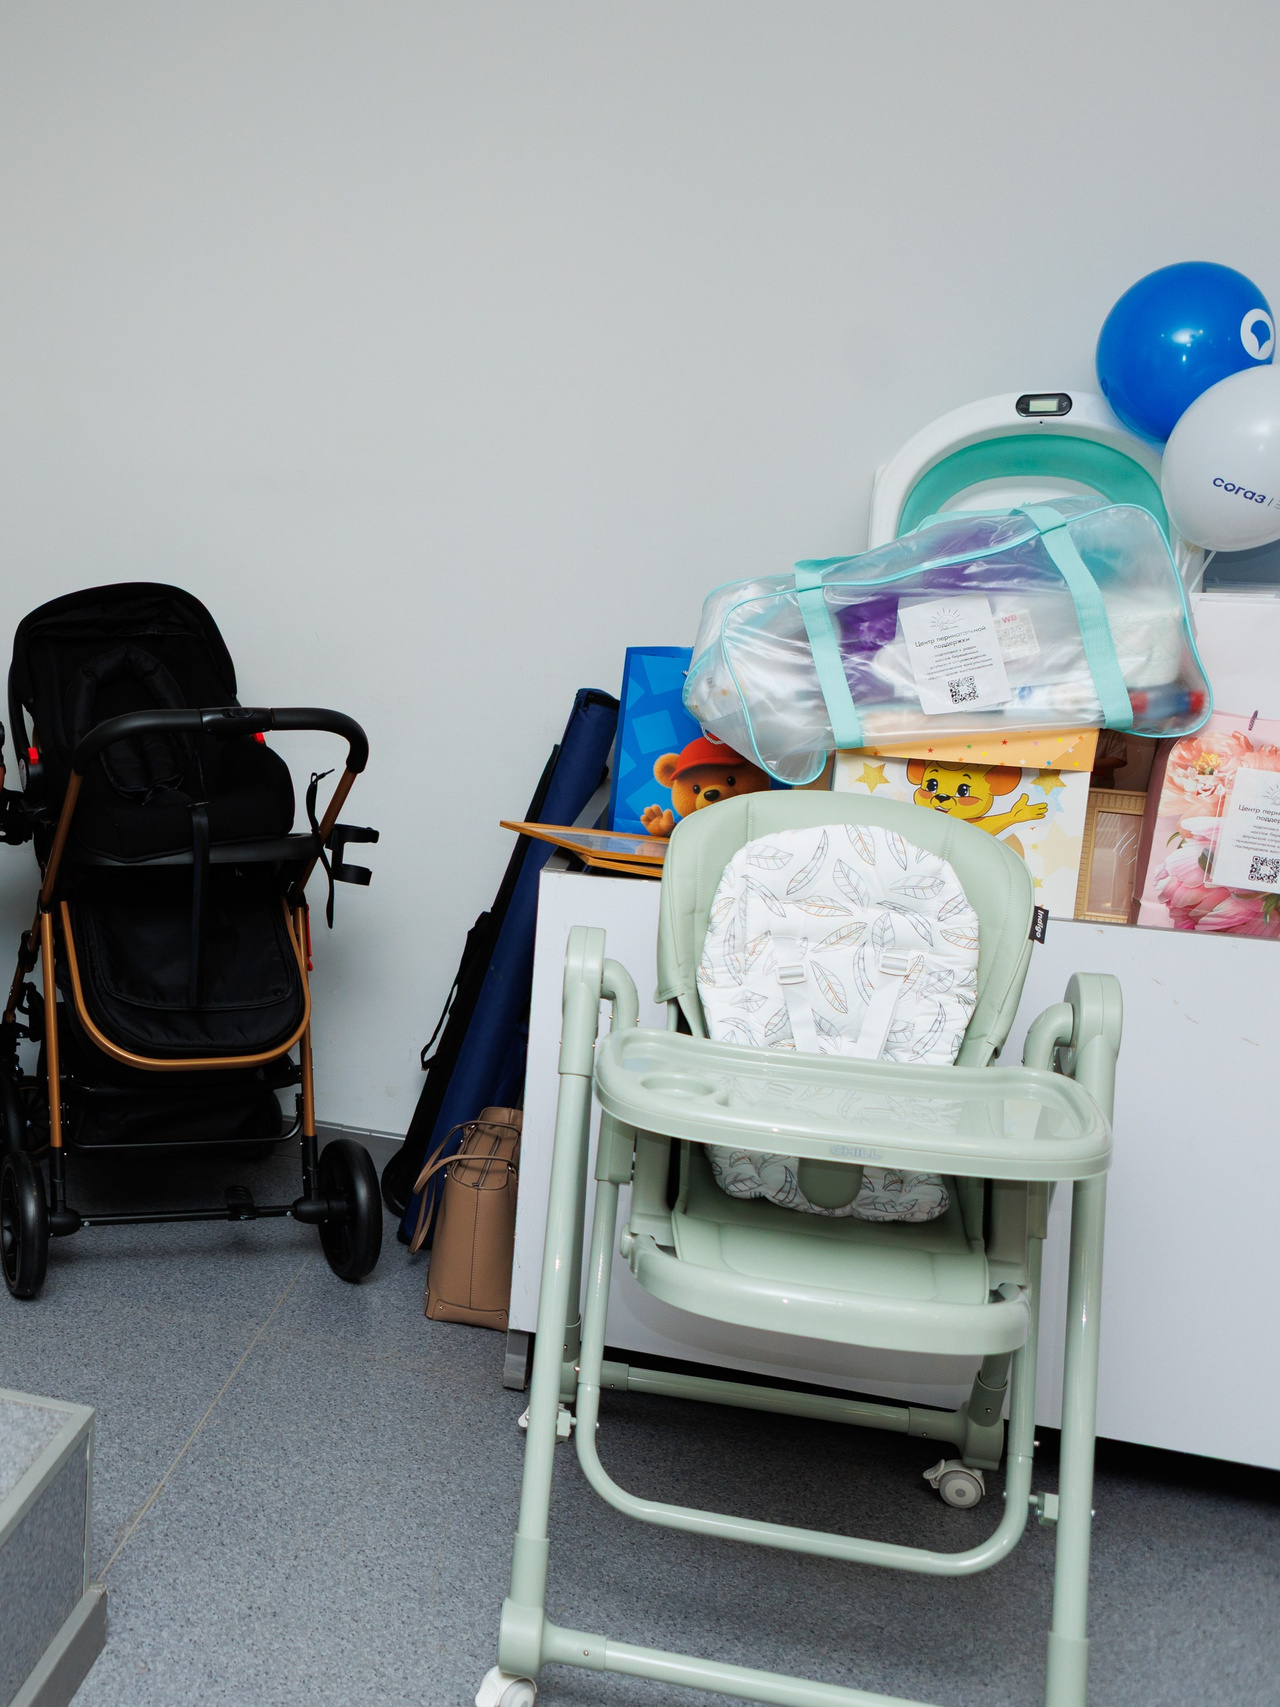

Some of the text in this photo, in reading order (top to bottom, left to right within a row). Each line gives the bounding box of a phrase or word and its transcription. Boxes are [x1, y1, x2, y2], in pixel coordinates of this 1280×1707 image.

[1002, 614, 1018, 624] WB
[914, 639, 935, 649] Центр
[936, 626, 987, 642] перинатальной
[933, 637, 970, 650] поддержки
[1238, 804, 1261, 814] Центр
[1035, 910, 1045, 939] Indigo
[830, 1145, 882, 1160] CHILL
